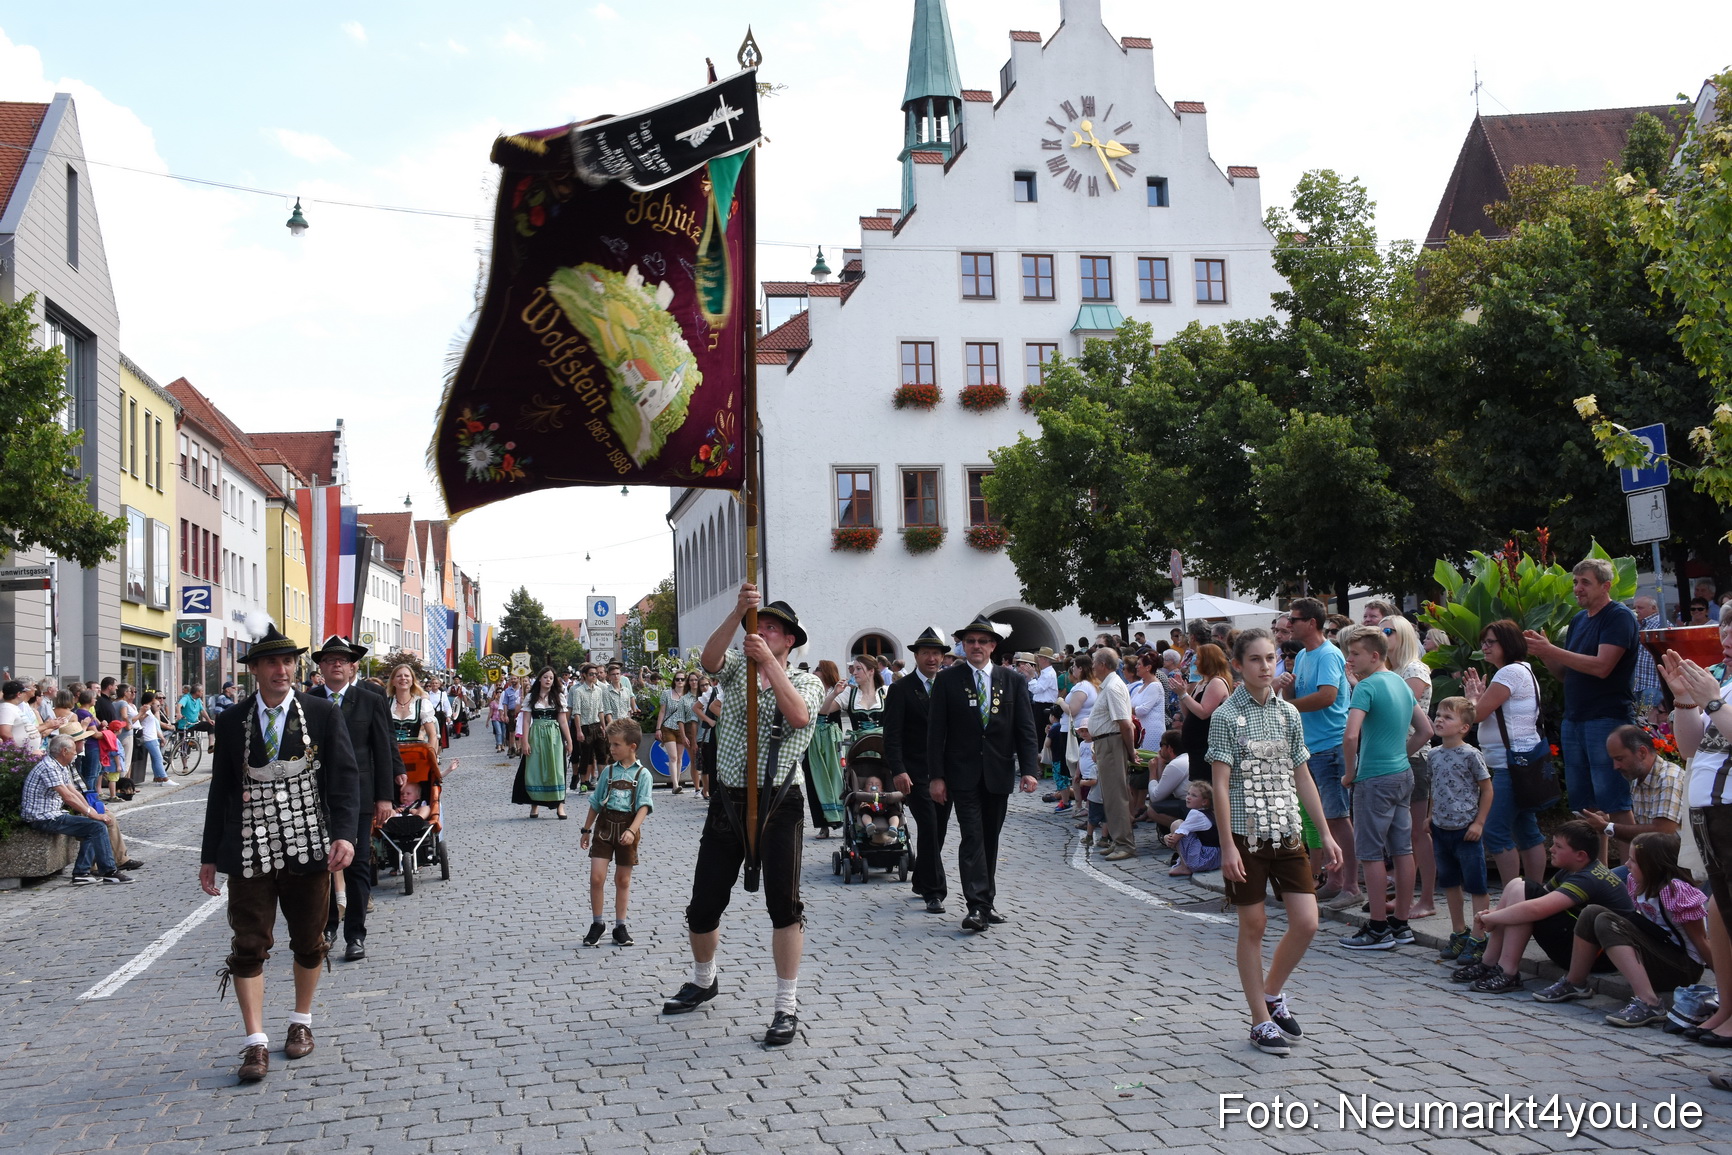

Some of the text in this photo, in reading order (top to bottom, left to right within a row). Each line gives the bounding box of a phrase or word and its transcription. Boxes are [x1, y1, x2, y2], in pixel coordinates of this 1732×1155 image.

[639, 119, 672, 175] Den Toten
[625, 191, 704, 246] Schütz
[521, 287, 608, 414] Wolfstein
